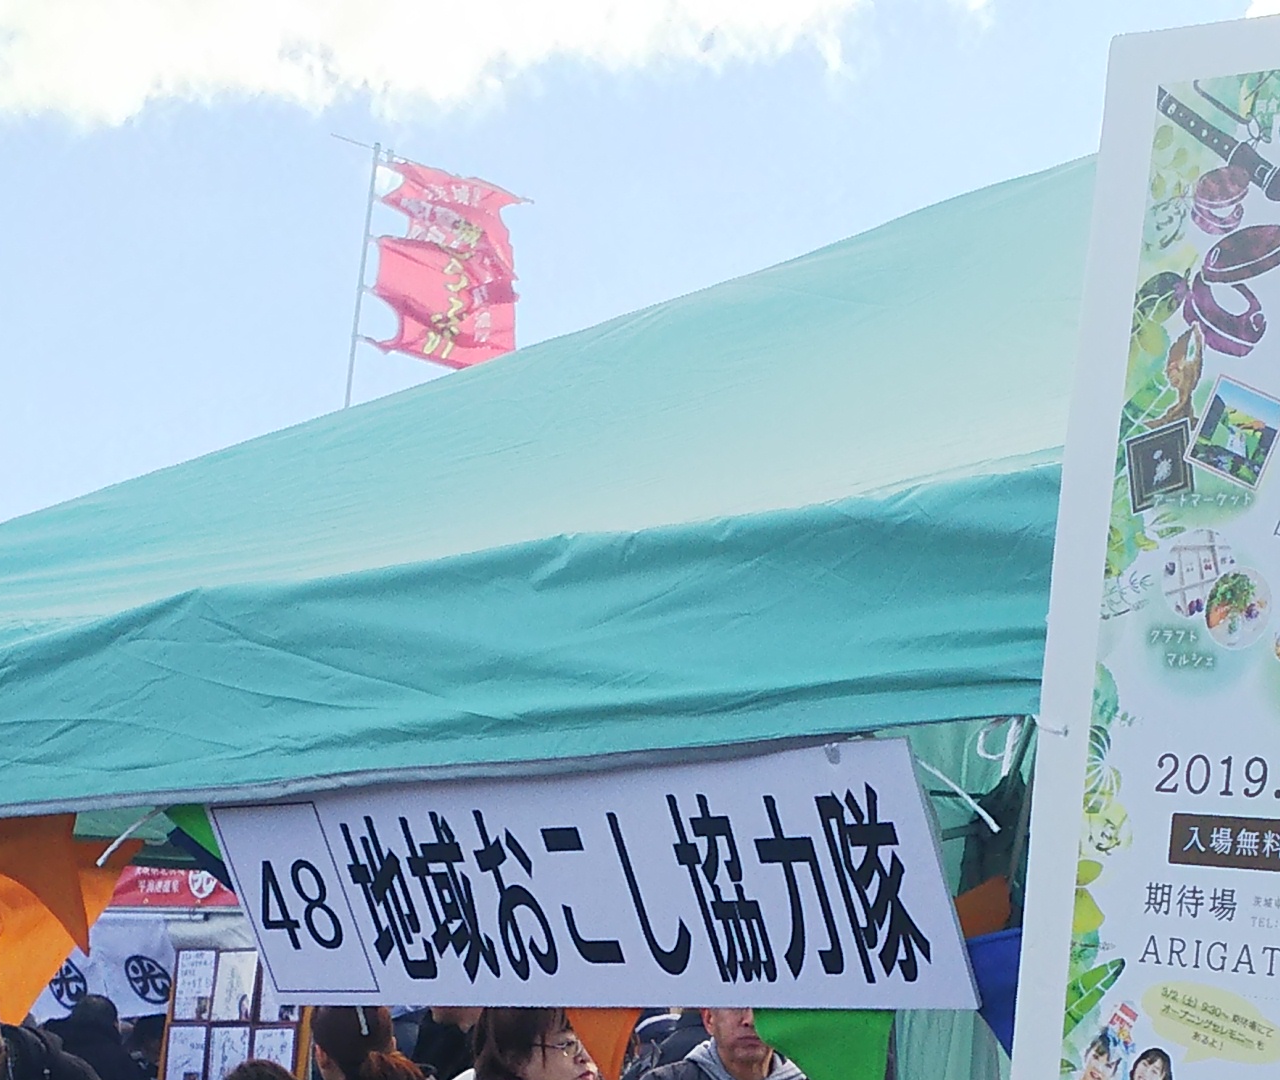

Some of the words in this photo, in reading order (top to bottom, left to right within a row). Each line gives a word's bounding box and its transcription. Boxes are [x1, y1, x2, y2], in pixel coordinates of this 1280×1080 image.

[1151, 628, 1198, 645] クラフト
[1166, 652, 1216, 668] マルシェ
[341, 782, 930, 984] 地域おこし協力隊
[1143, 882, 1238, 922] 期待場
[261, 857, 344, 951] 48
